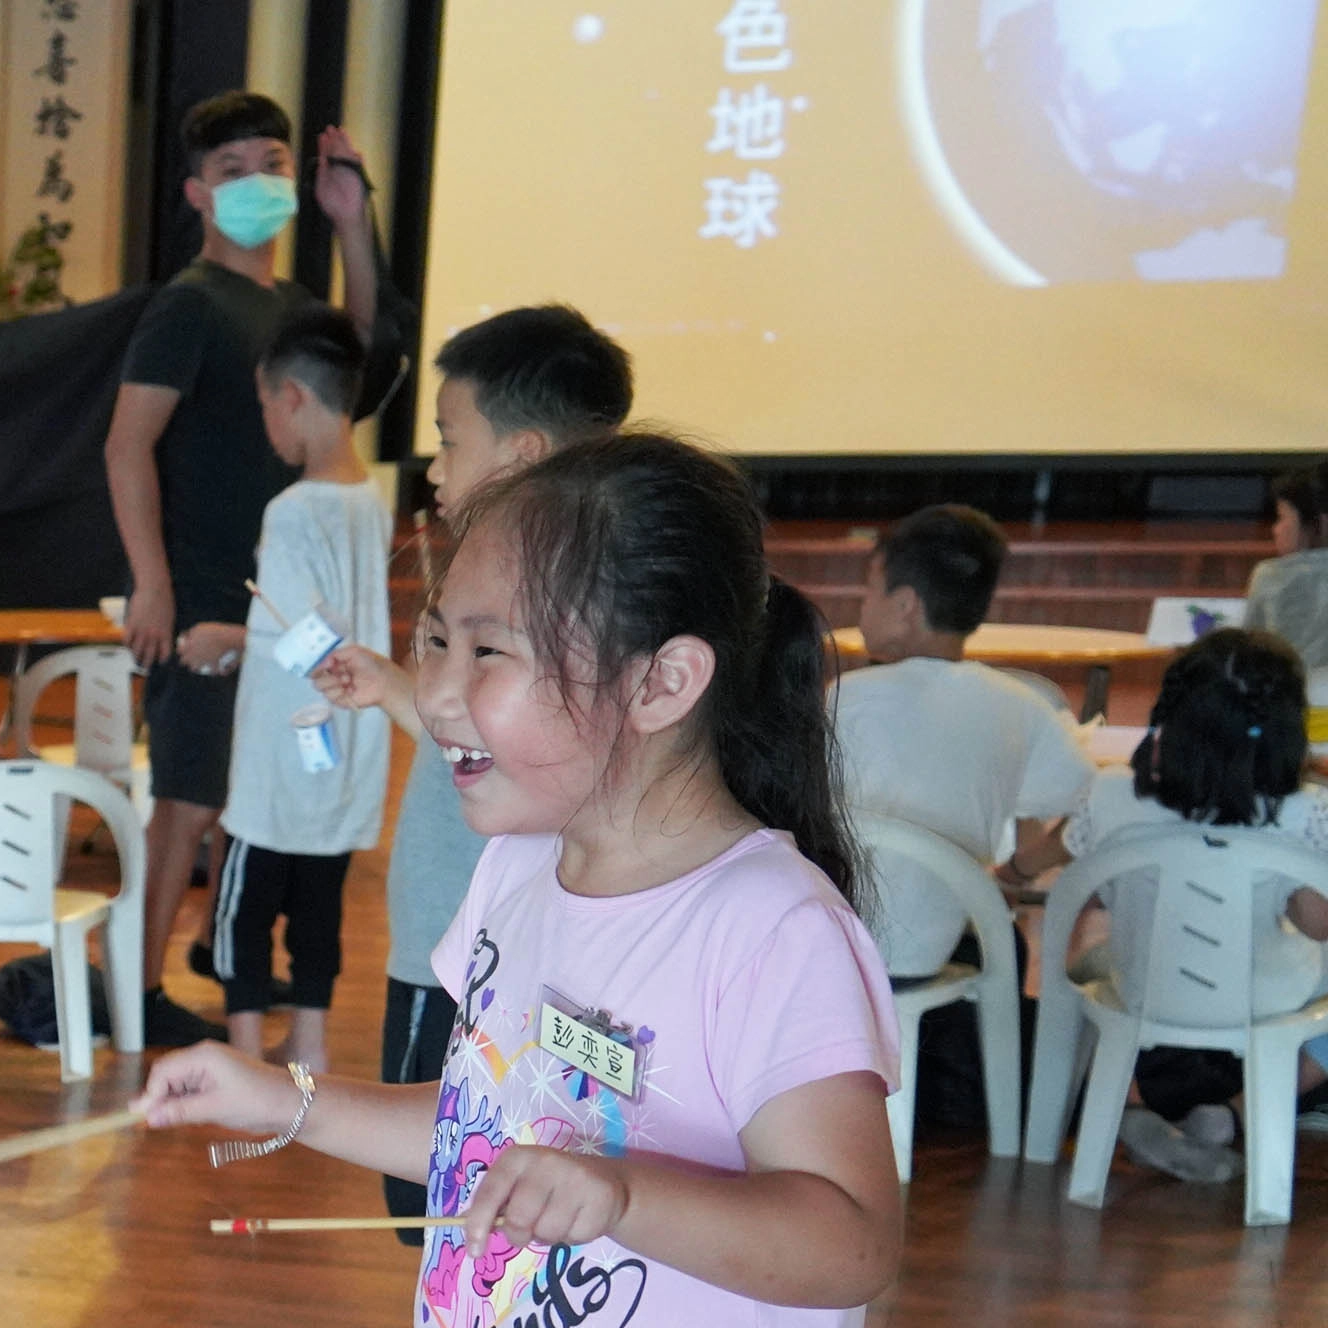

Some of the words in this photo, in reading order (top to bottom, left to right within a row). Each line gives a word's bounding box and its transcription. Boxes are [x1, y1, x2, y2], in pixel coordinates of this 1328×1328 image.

[698, 0, 793, 248] 色地球
[550, 1014, 625, 1082] 彭奕宣
